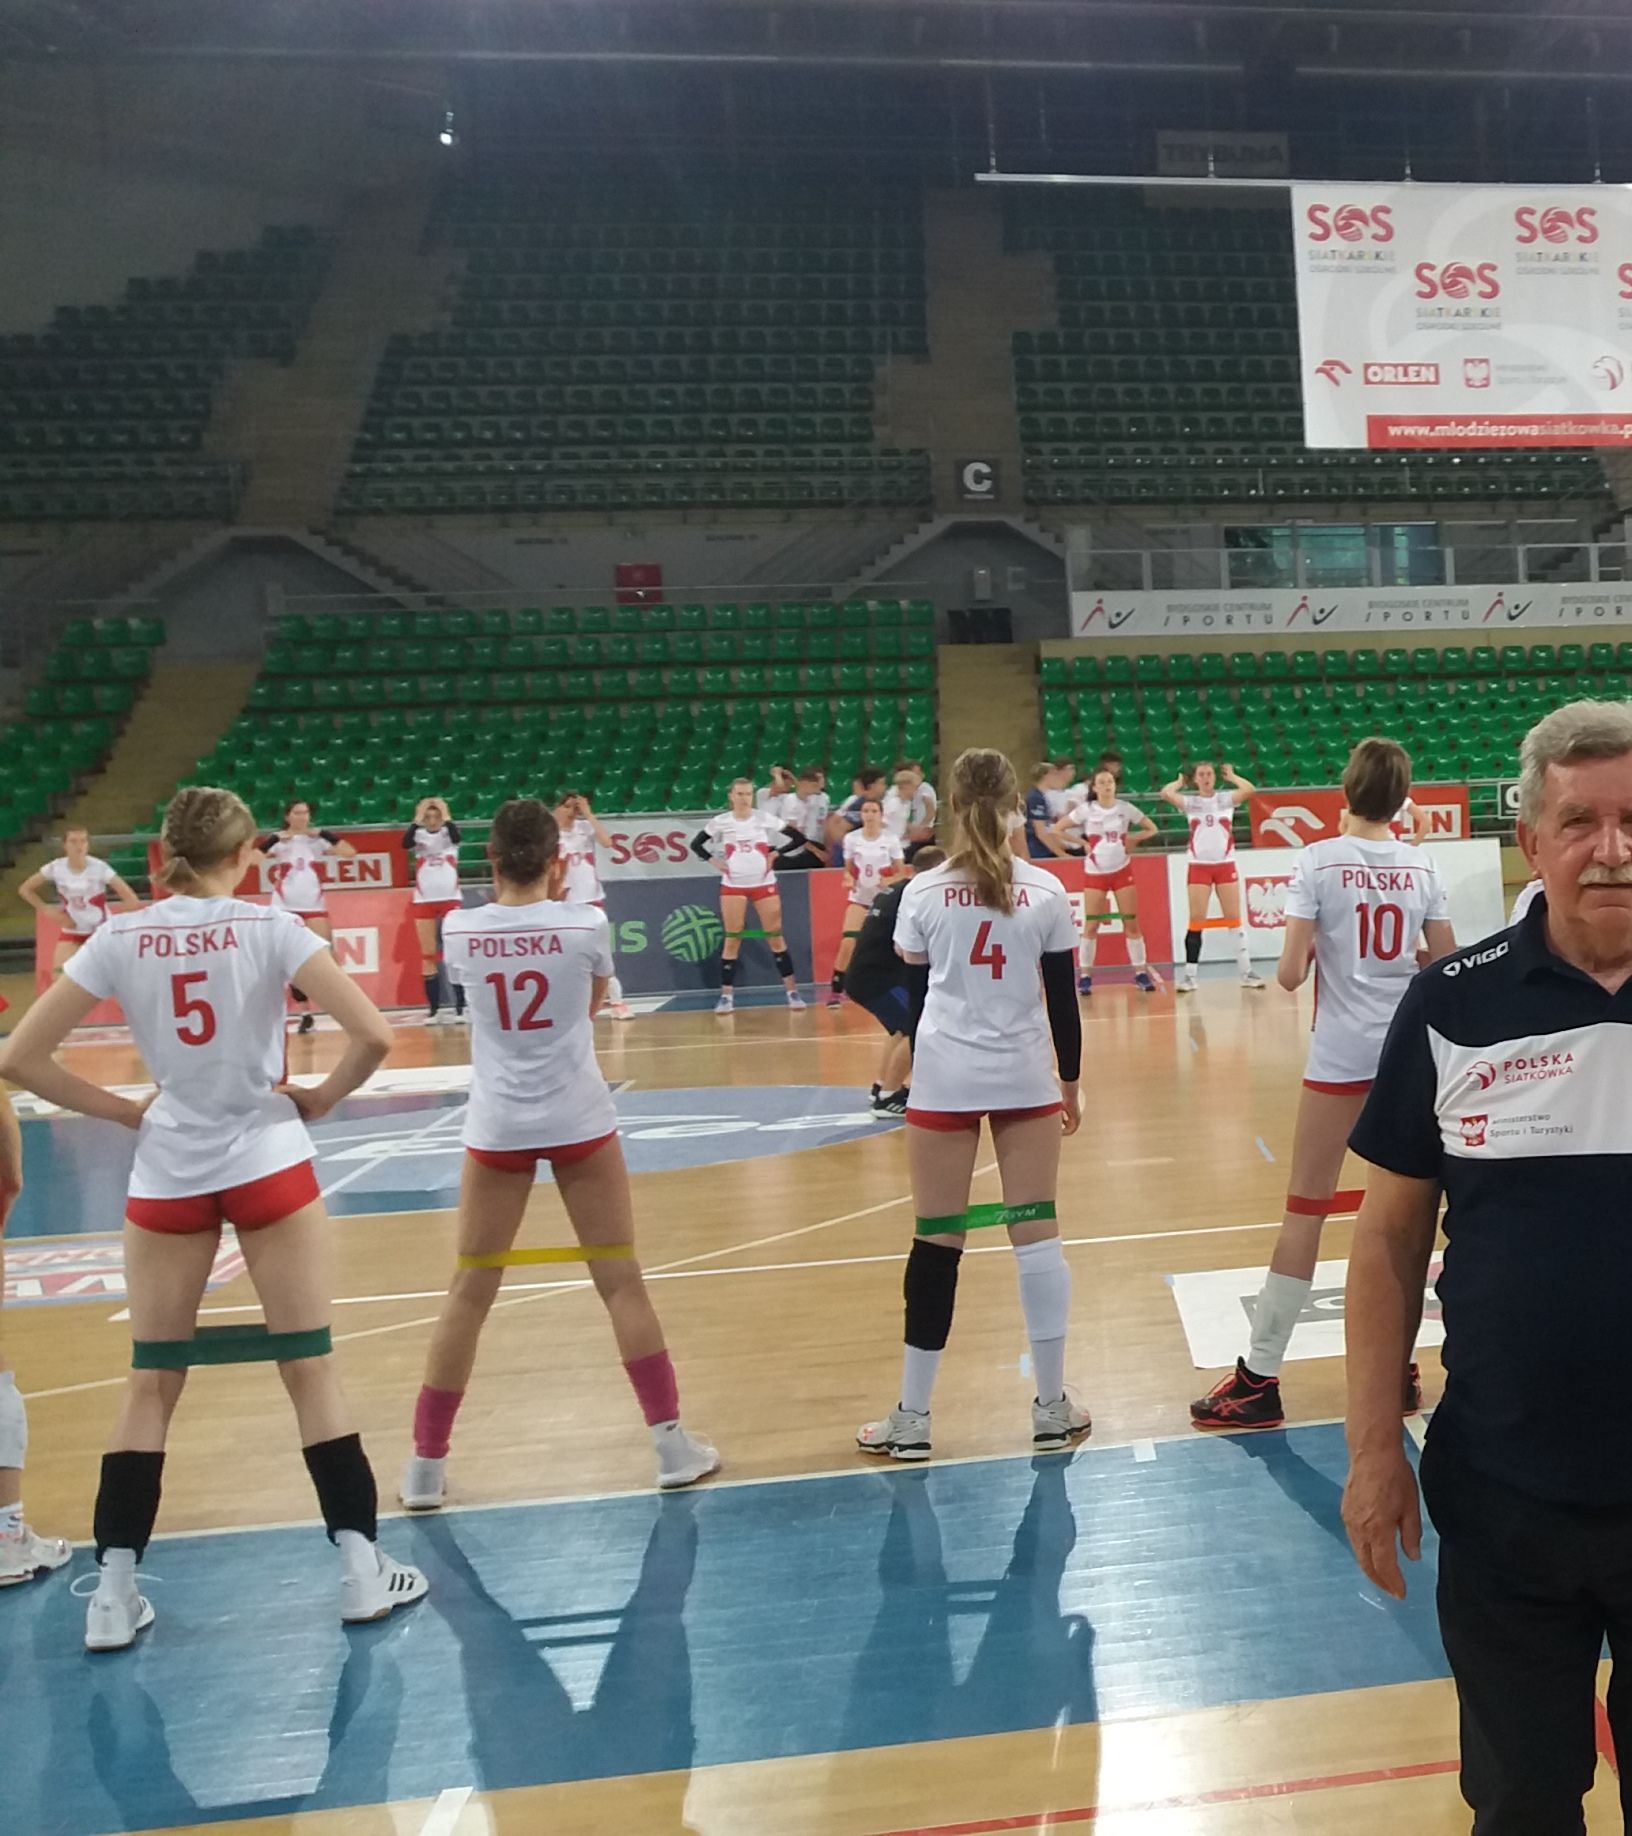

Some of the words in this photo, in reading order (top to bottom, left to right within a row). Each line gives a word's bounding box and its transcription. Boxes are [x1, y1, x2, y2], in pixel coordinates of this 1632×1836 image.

[1307, 203, 1395, 242] SOS
[1515, 206, 1599, 244] SOS
[1414, 262, 1501, 299] SOS
[1366, 365, 1437, 383] ORLEN
[962, 461, 993, 492] C
[611, 831, 690, 865] SOS
[266, 857, 383, 886] OLEN
[1341, 870, 1415, 891] POLSKA
[943, 887, 1031, 908] POLA
[138, 926, 239, 959] POLSKA
[467, 934, 564, 958] POLSKA
[1355, 902, 1405, 962] 10
[969, 920, 1007, 981] 4
[171, 970, 217, 1047] 5
[485, 970, 555, 1032] 12
[1503, 1052, 1575, 1072] POLSKA
[1504, 1065, 1574, 1086] SIATKÓWKA
[1489, 1127, 1521, 1138] Sportu
[1530, 1124, 1574, 1137] Turystyki
